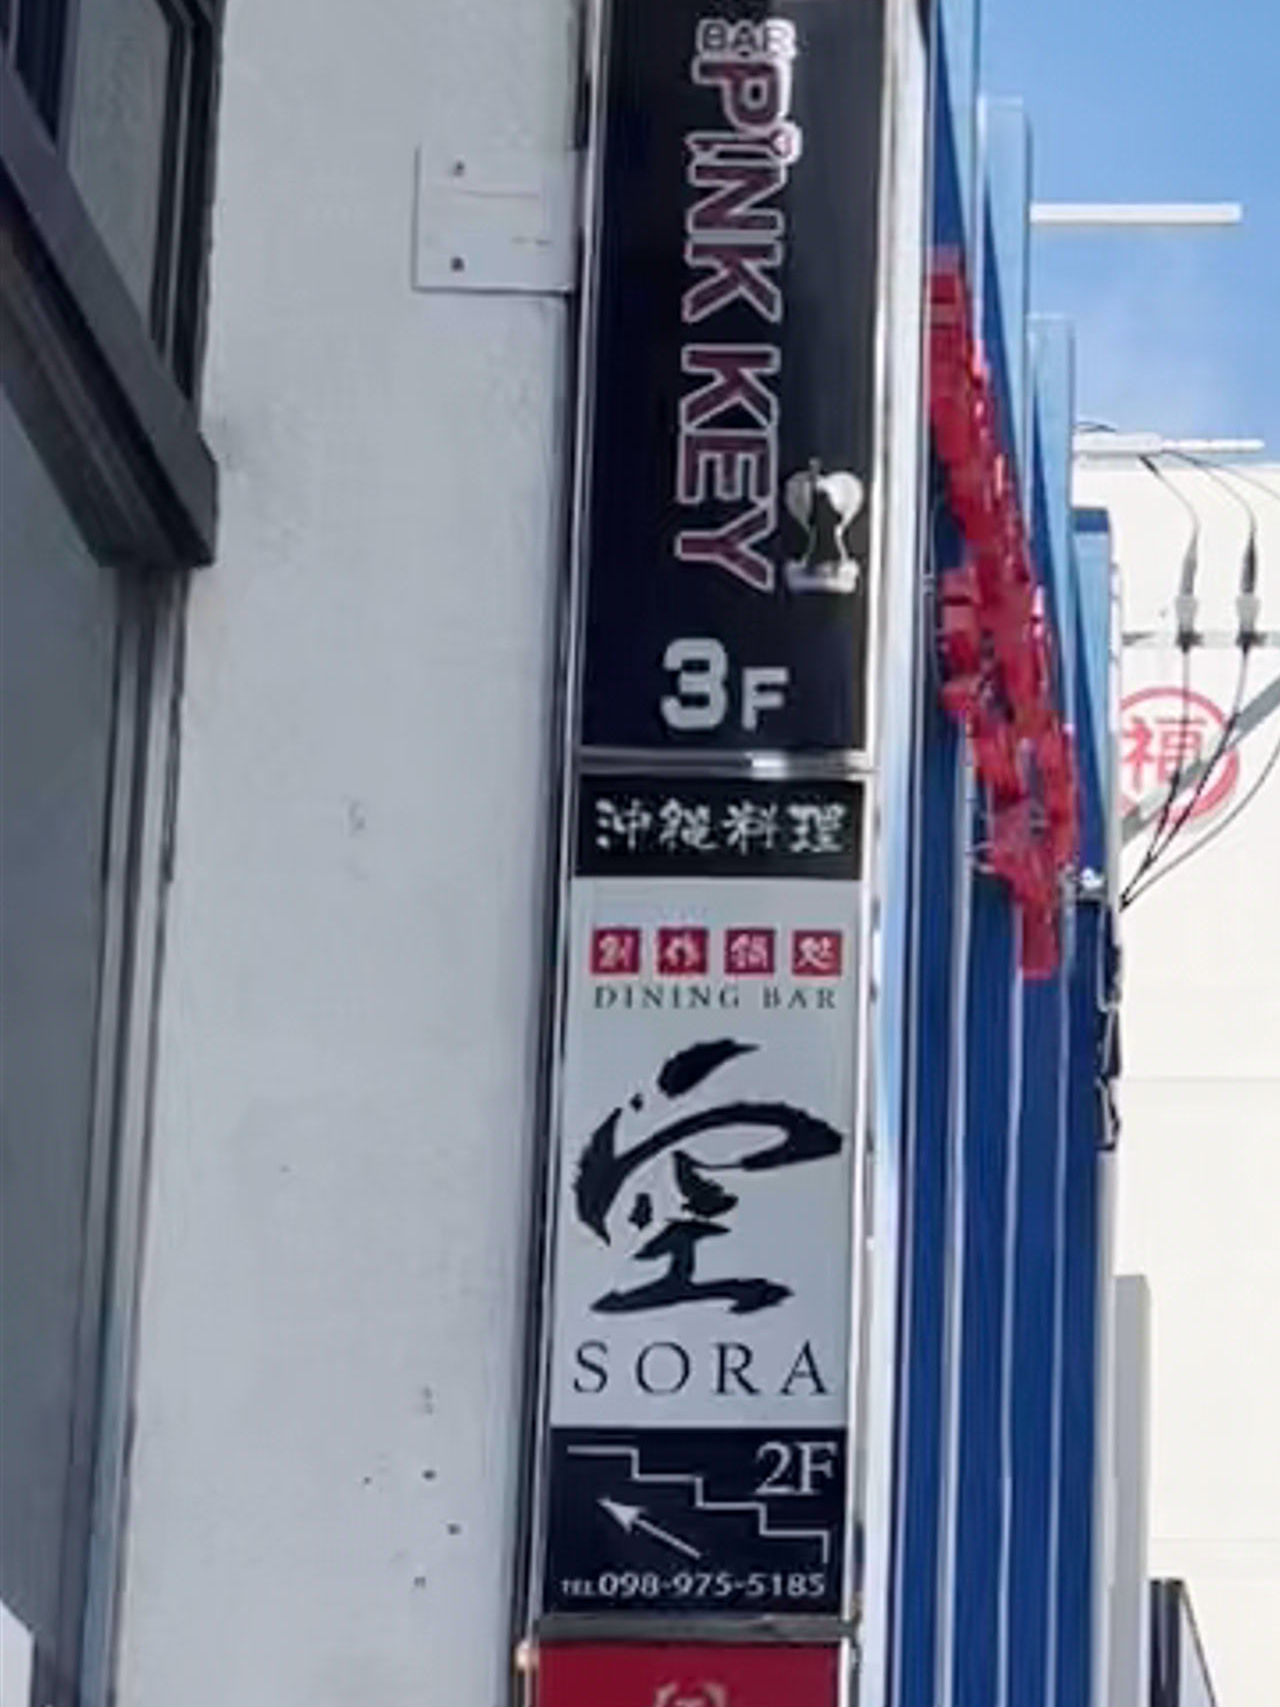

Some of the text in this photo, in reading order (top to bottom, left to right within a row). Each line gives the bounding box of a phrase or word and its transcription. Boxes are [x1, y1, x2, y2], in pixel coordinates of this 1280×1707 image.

[695, 18, 797, 61] BAR
[675, 58, 802, 592] PINK KEY
[660, 638, 789, 732] 3F
[595, 798, 848, 855] 沖縄料理
[594, 985, 837, 1011] DINING BAR
[573, 1037, 844, 1315] 空
[572, 1341, 832, 1397] SORA
[754, 1442, 839, 1495] 2F
